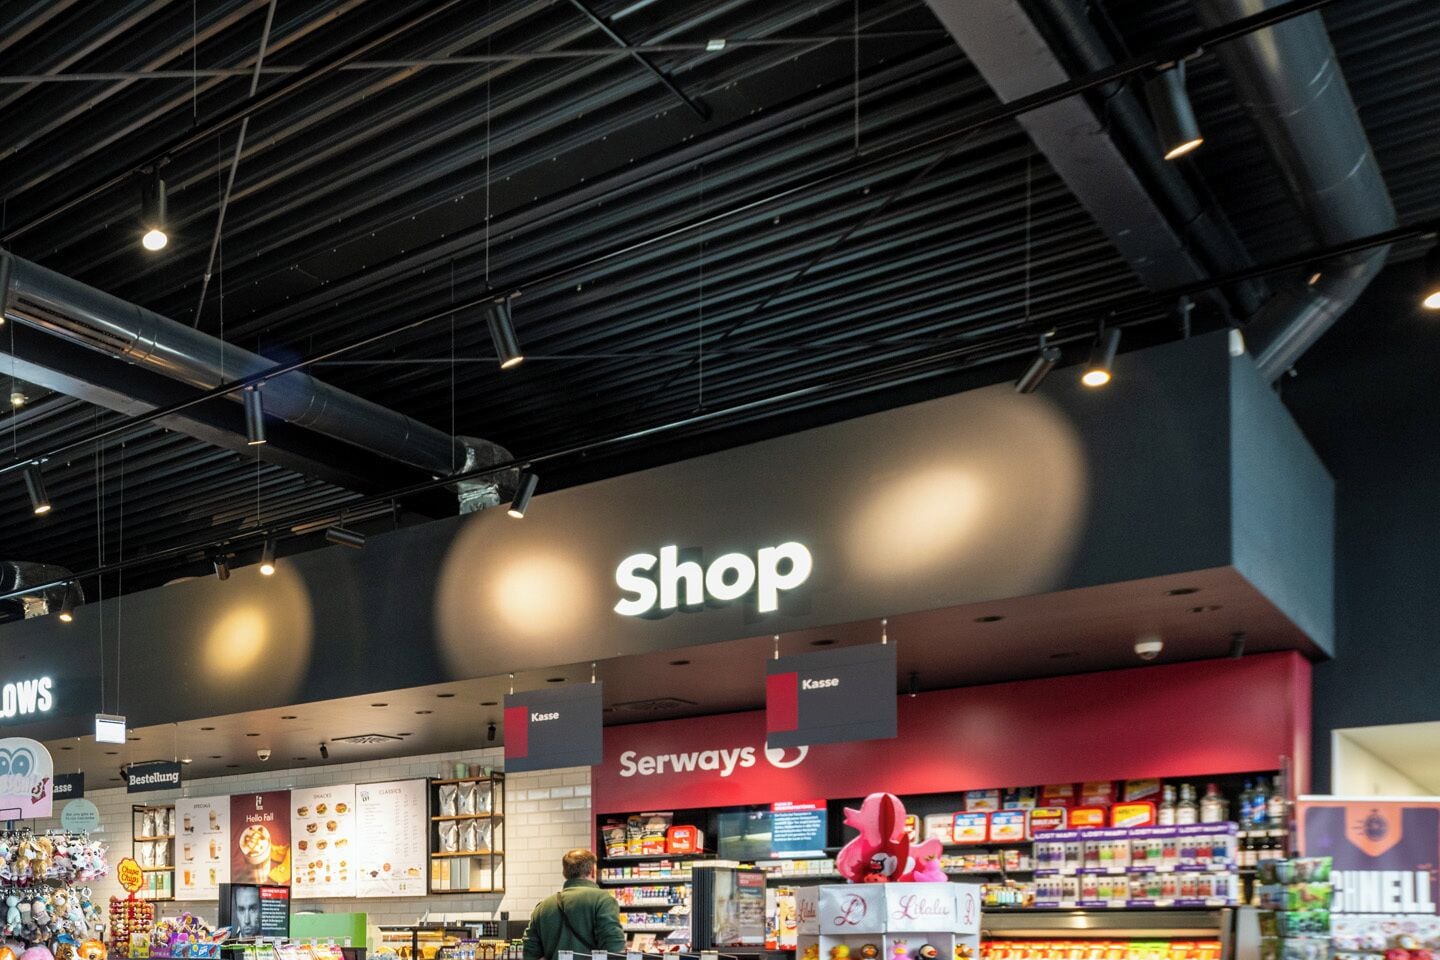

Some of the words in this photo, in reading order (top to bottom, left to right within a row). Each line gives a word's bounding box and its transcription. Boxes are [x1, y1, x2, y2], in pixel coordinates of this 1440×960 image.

[614, 541, 812, 617] Shop
[802, 676, 840, 690] Kasse
[531, 711, 560, 723] Kasse
[619, 744, 757, 778] Serways
[128, 770, 179, 788] Bestellung
[52, 783, 73, 794] asse
[245, 813, 263, 823] Hello
[263, 812, 275, 822] Fall
[121, 865, 140, 876] Chupa
[121, 873, 140, 884] Chups
[1330, 871, 1436, 912] CHNELL
